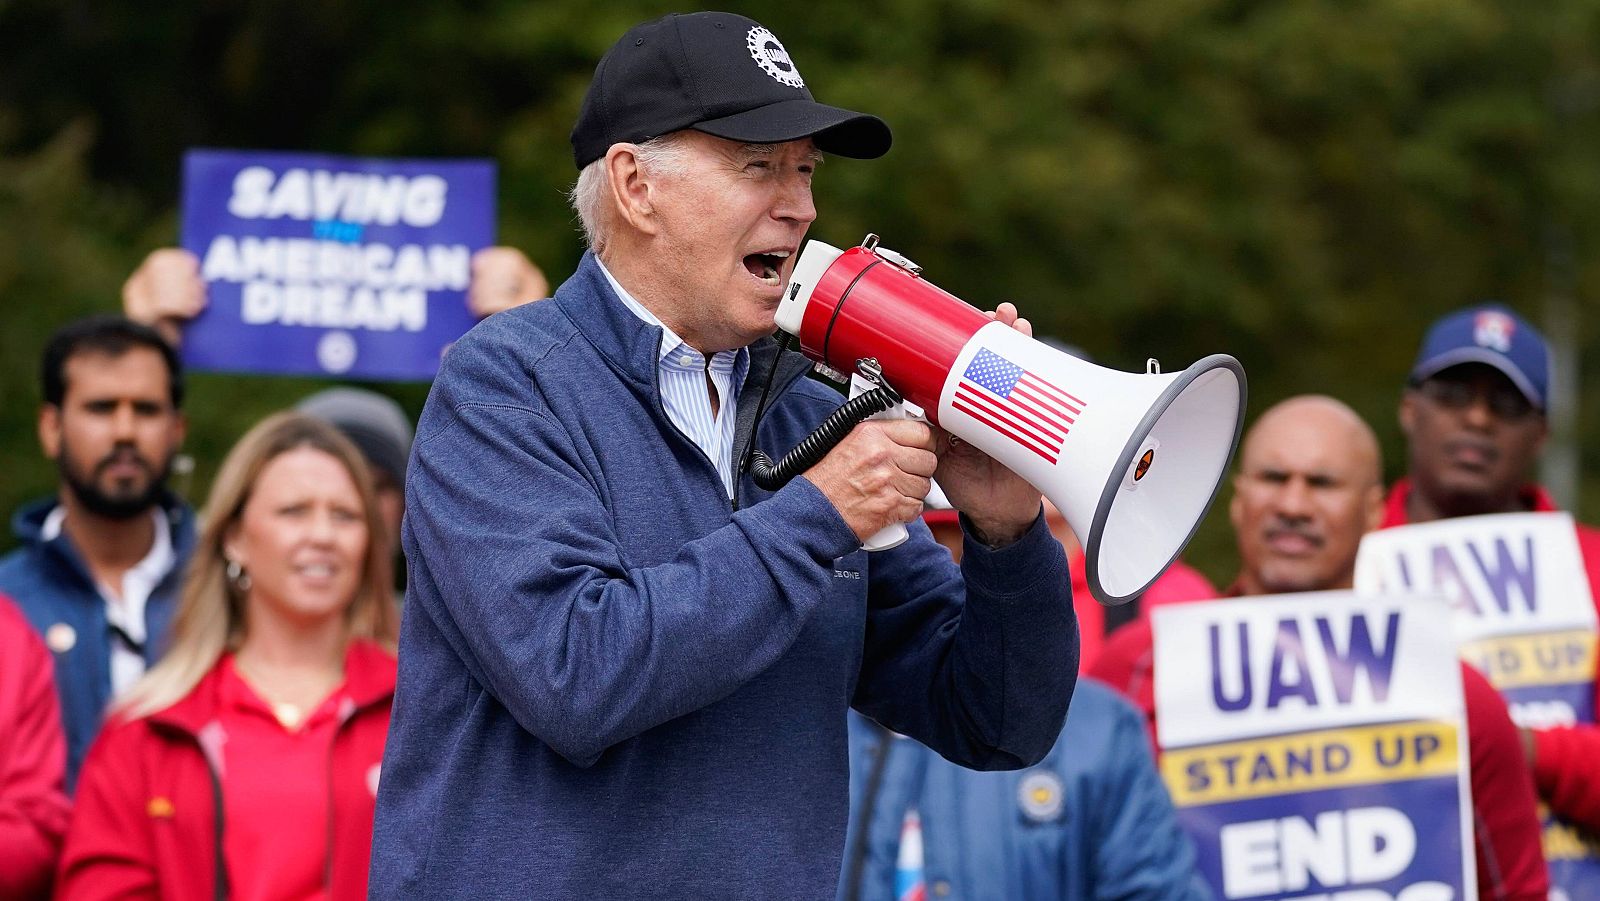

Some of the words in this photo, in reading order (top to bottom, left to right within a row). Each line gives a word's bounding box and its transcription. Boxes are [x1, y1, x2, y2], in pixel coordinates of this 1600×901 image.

[228, 166, 448, 227] SAVING
[203, 235, 471, 292] AMERICAN
[241, 281, 428, 332] DREAM
[1209, 611, 1400, 713] UAW
[1185, 743, 1351, 794] STAND
[1373, 734, 1442, 769] UP
[1220, 806, 1417, 900] END
